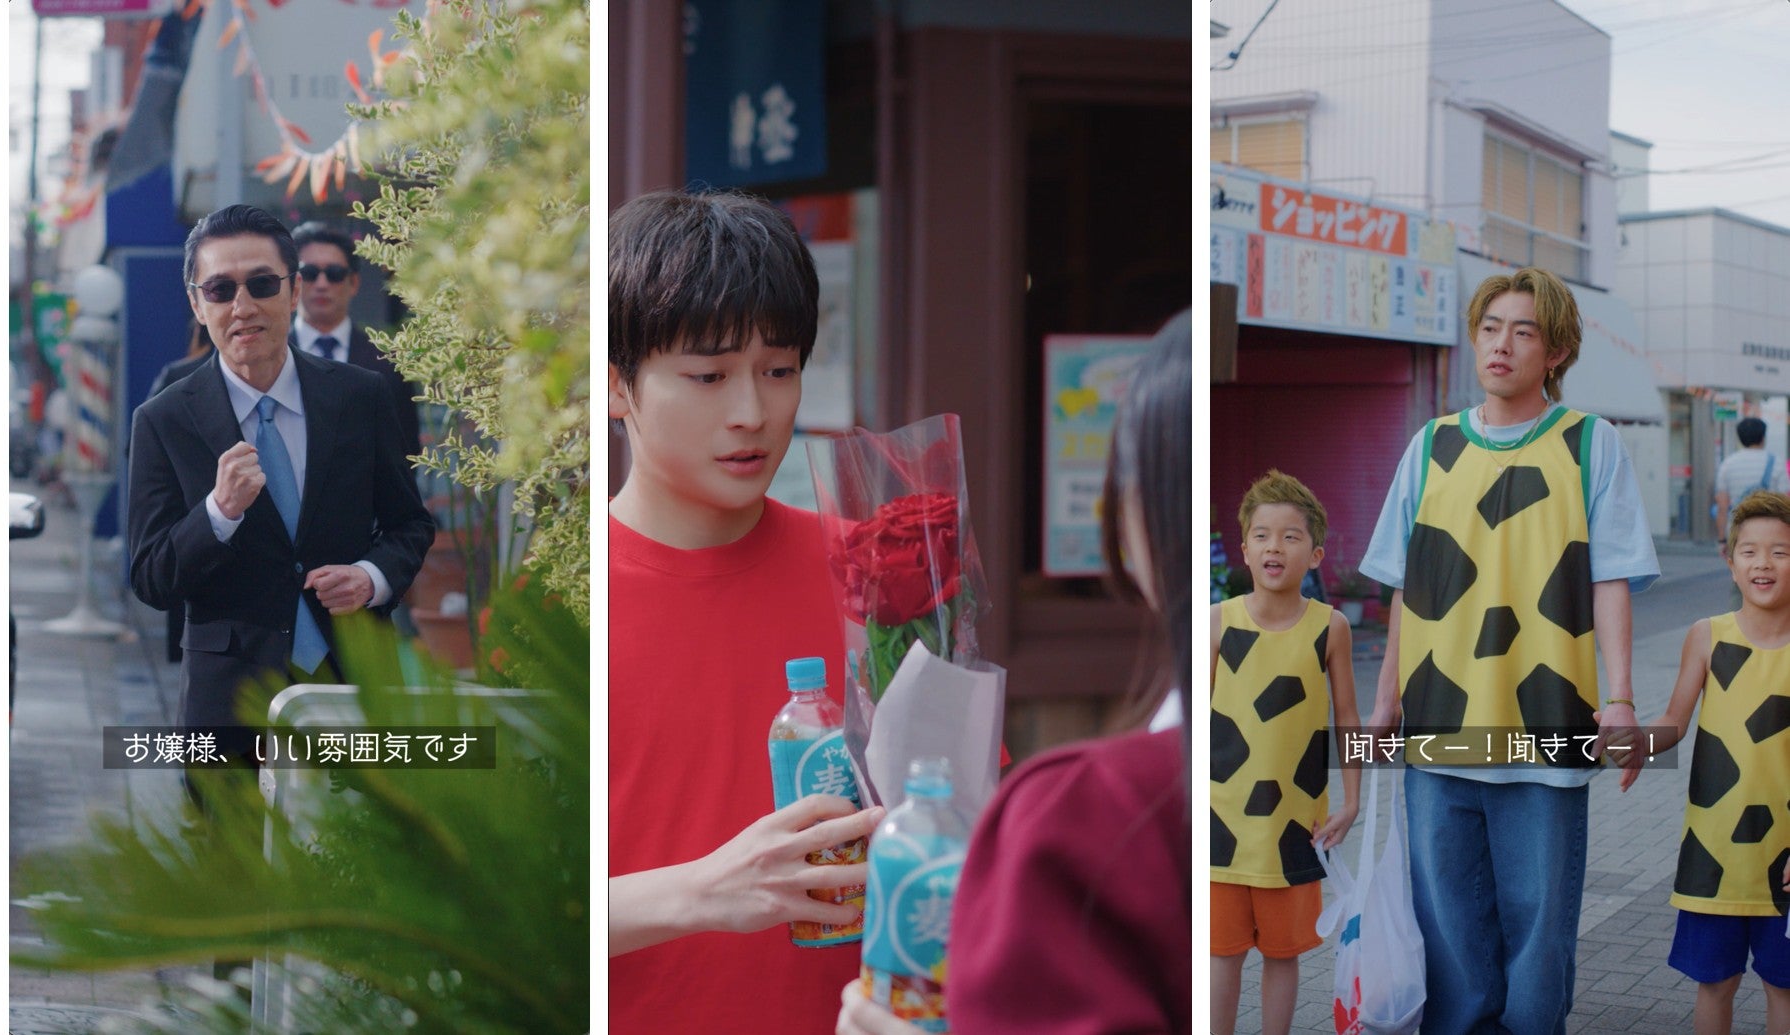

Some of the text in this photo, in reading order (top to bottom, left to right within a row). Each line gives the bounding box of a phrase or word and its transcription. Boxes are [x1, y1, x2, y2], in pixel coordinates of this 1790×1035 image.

[1271, 187, 1400, 250] ショッピング
